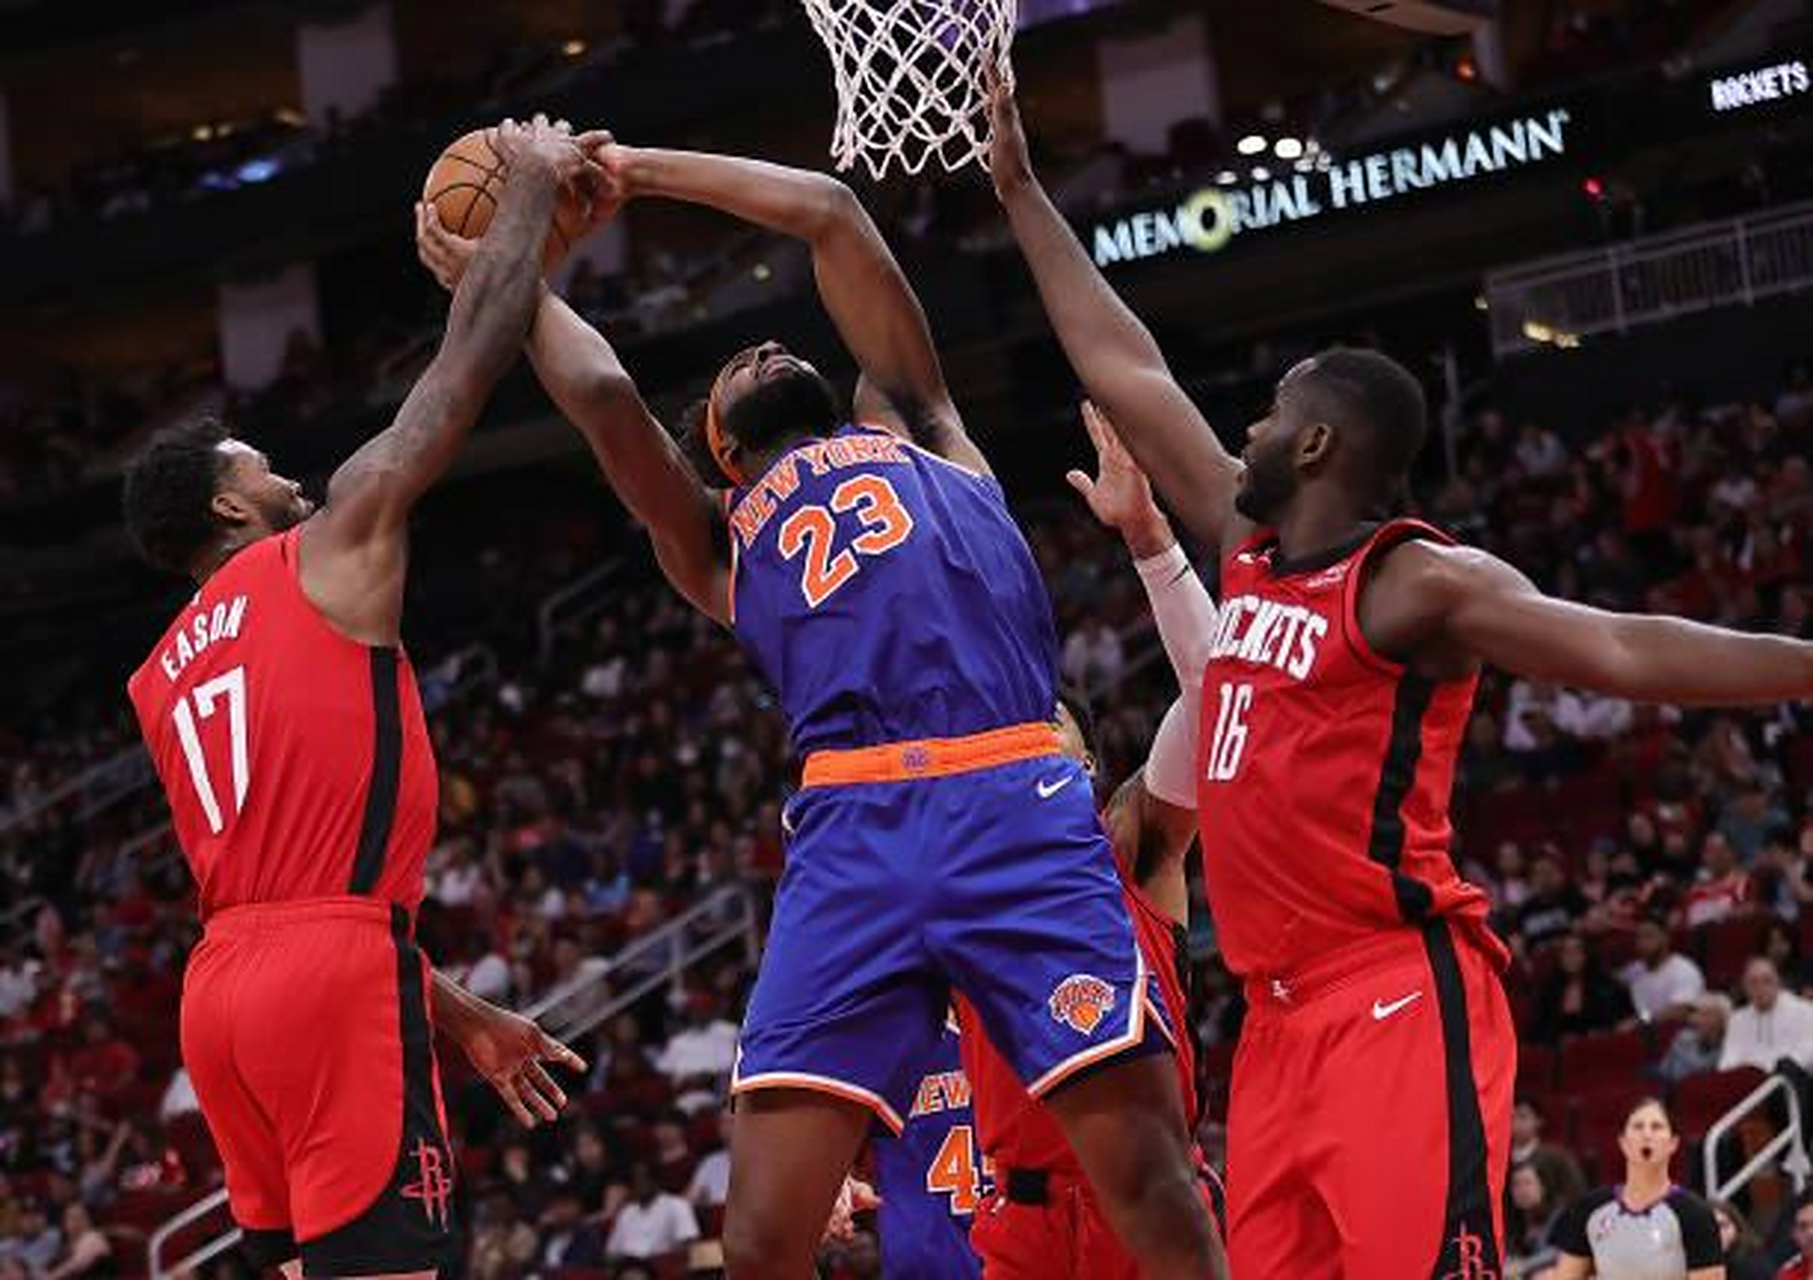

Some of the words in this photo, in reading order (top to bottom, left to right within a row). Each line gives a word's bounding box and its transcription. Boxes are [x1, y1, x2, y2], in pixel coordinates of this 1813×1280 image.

[1711, 60, 1810, 112] ROCKETS
[1095, 173, 1321, 266] MEMORIAL
[1330, 108, 1565, 208] HERMANN
[729, 449, 800, 549] NEW
[799, 435, 911, 476] YORK
[778, 473, 914, 608] 23
[160, 595, 247, 681] EASON
[172, 664, 249, 834] 17
[1207, 682, 1255, 781] 16
